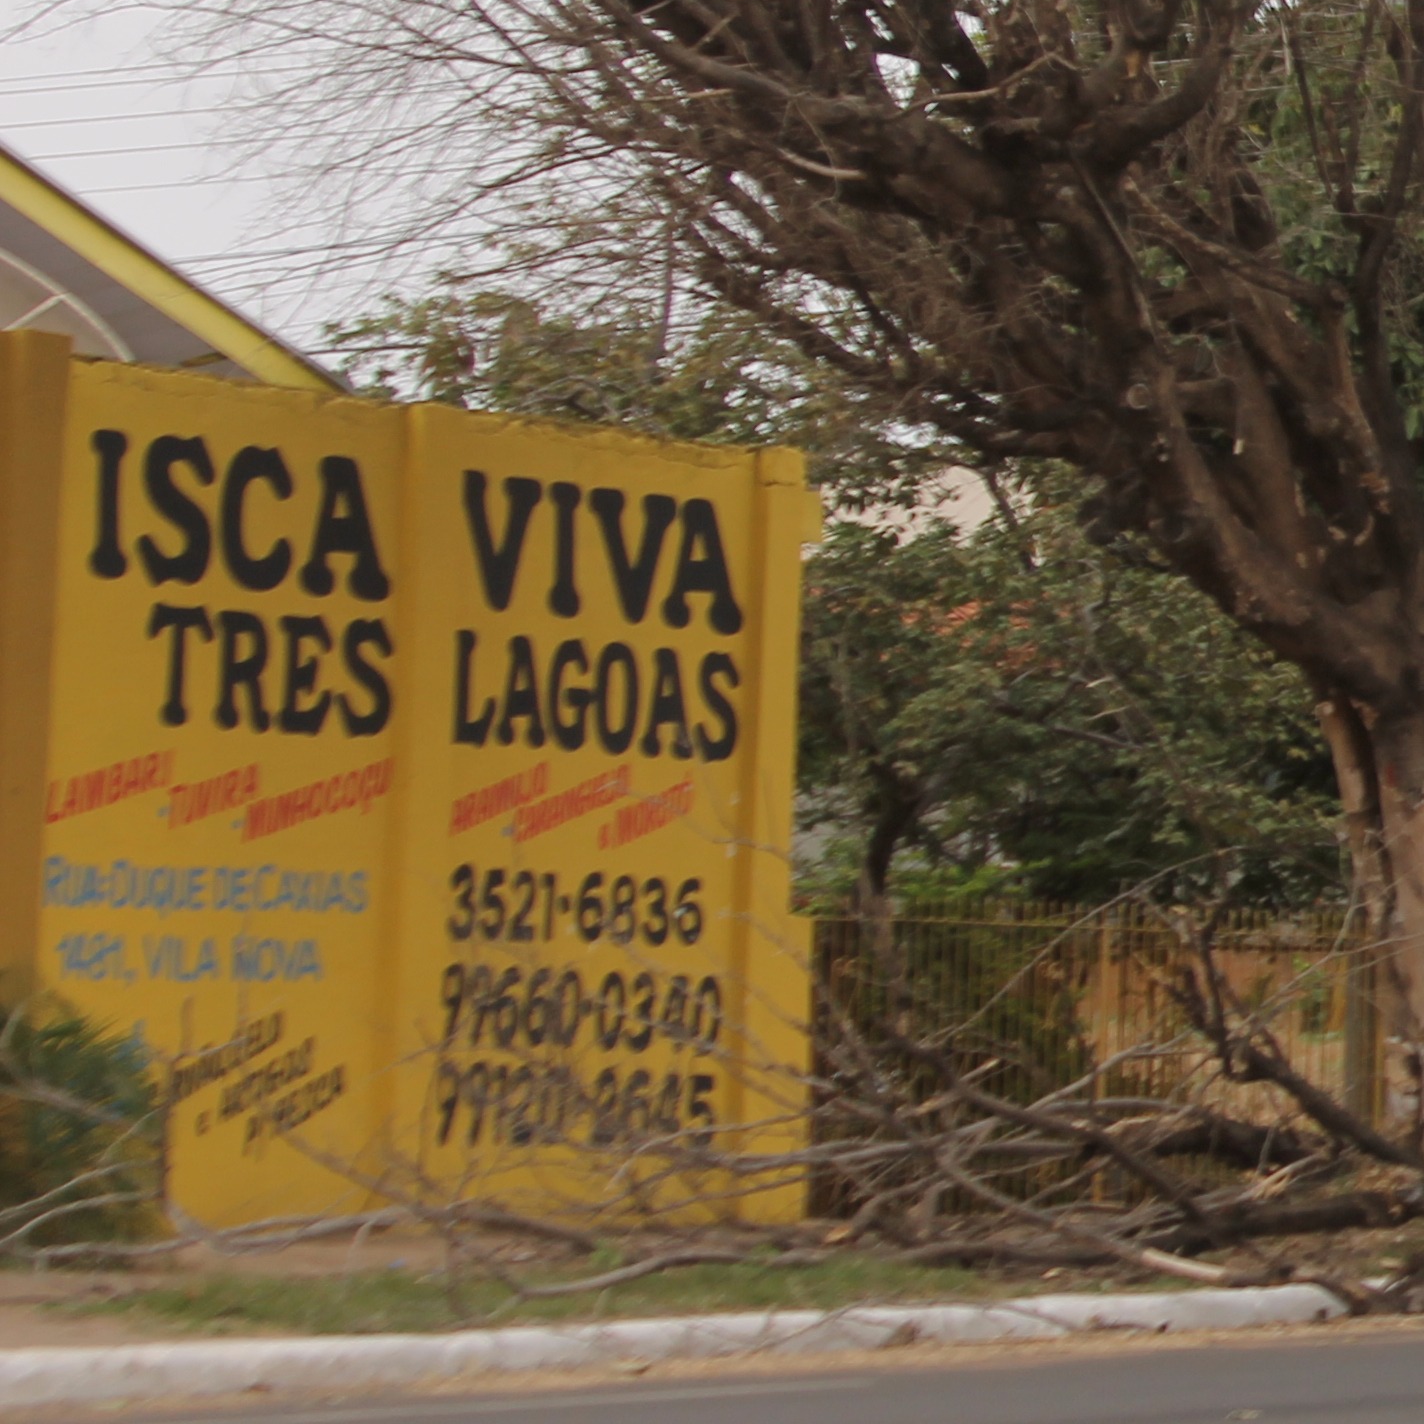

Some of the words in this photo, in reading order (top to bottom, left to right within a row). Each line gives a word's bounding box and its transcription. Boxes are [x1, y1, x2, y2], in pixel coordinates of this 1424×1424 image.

[89, 429, 391, 602] ISCA
[463, 469, 743, 636] VIVA
[147, 602, 394, 737] TRES
[453, 629, 741, 763] LAGOAS
